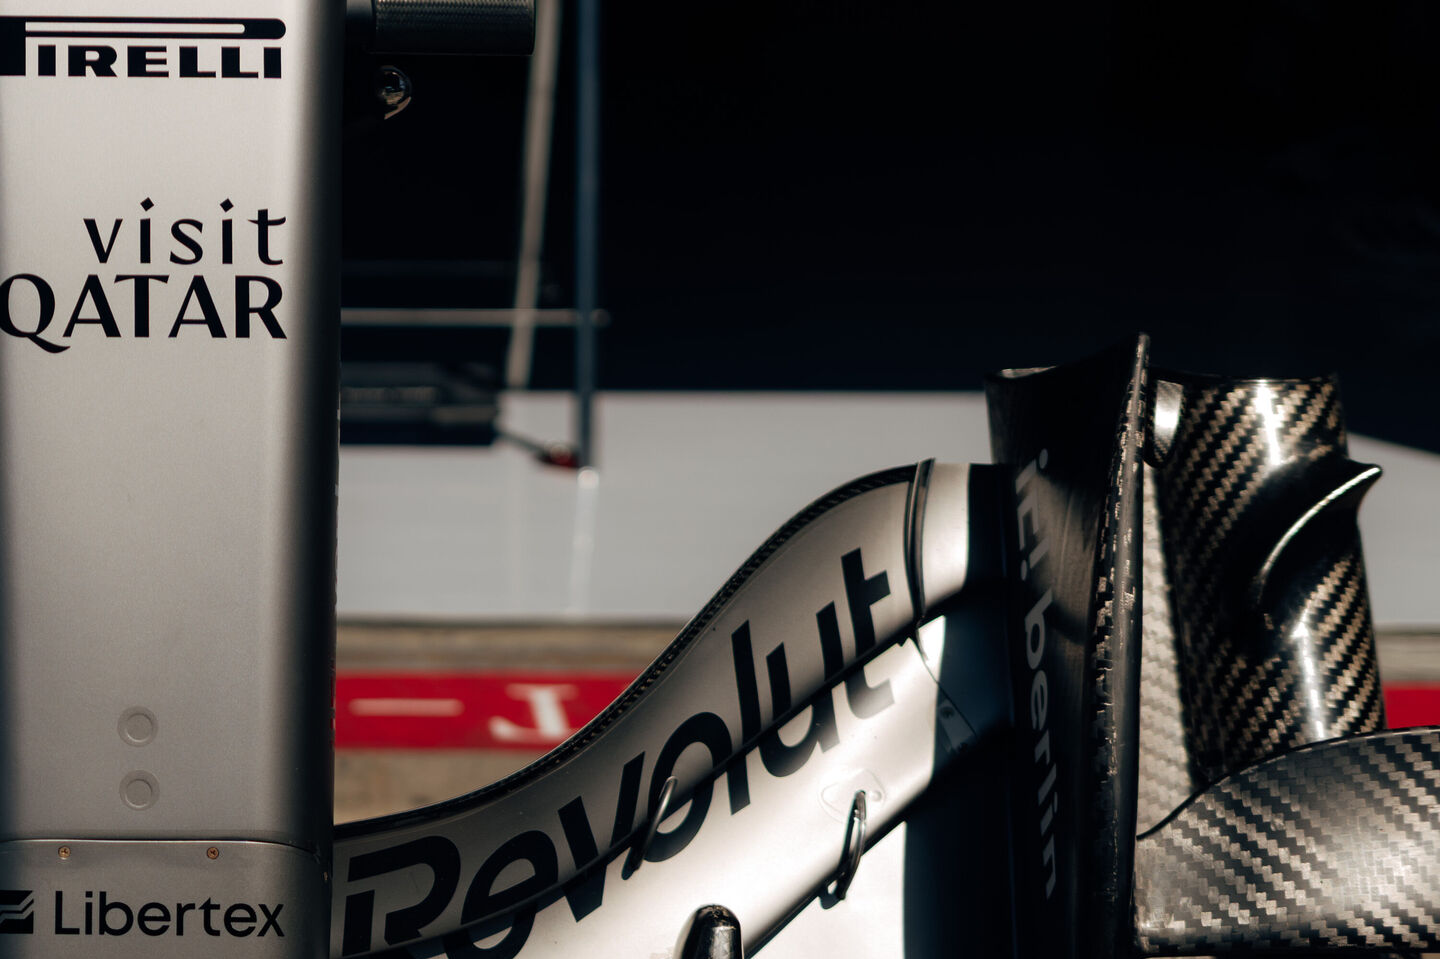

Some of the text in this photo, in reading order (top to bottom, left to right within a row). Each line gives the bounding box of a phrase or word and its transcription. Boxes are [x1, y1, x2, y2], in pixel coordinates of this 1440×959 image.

[82, 196, 287, 266] visit
[1023, 589, 1060, 900] berlin
[54, 890, 285, 938] Libertex
